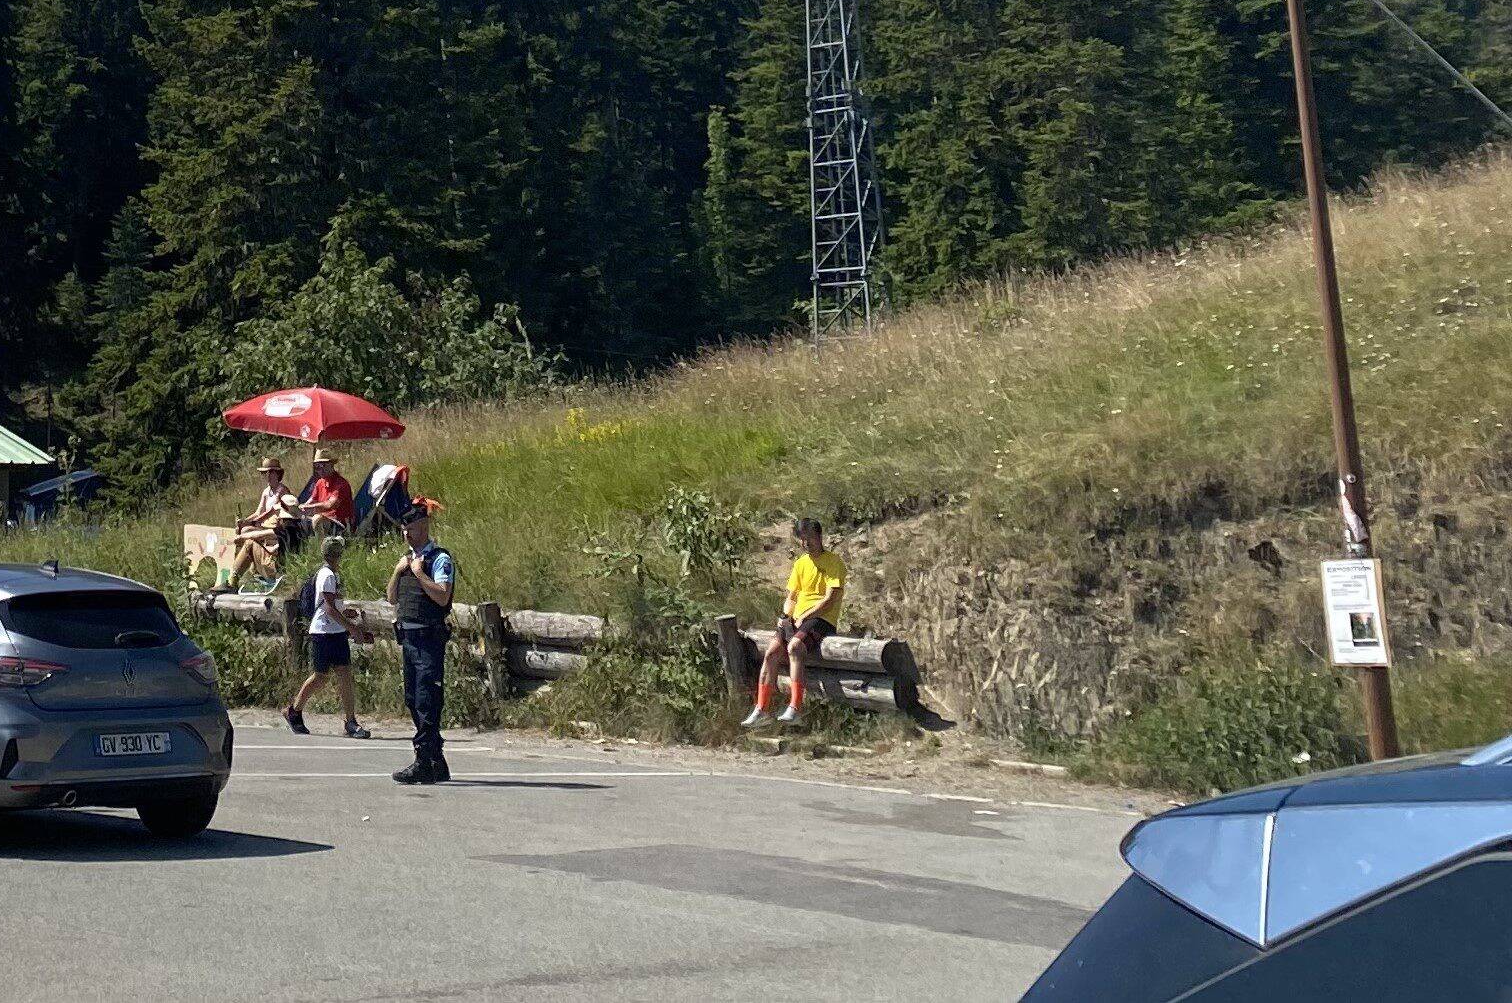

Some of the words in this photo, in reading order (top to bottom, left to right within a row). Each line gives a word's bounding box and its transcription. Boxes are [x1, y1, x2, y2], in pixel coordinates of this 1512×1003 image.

[102, 736, 117, 753] GV
[121, 735, 143, 752] 930
[145, 734, 161, 751] YC
